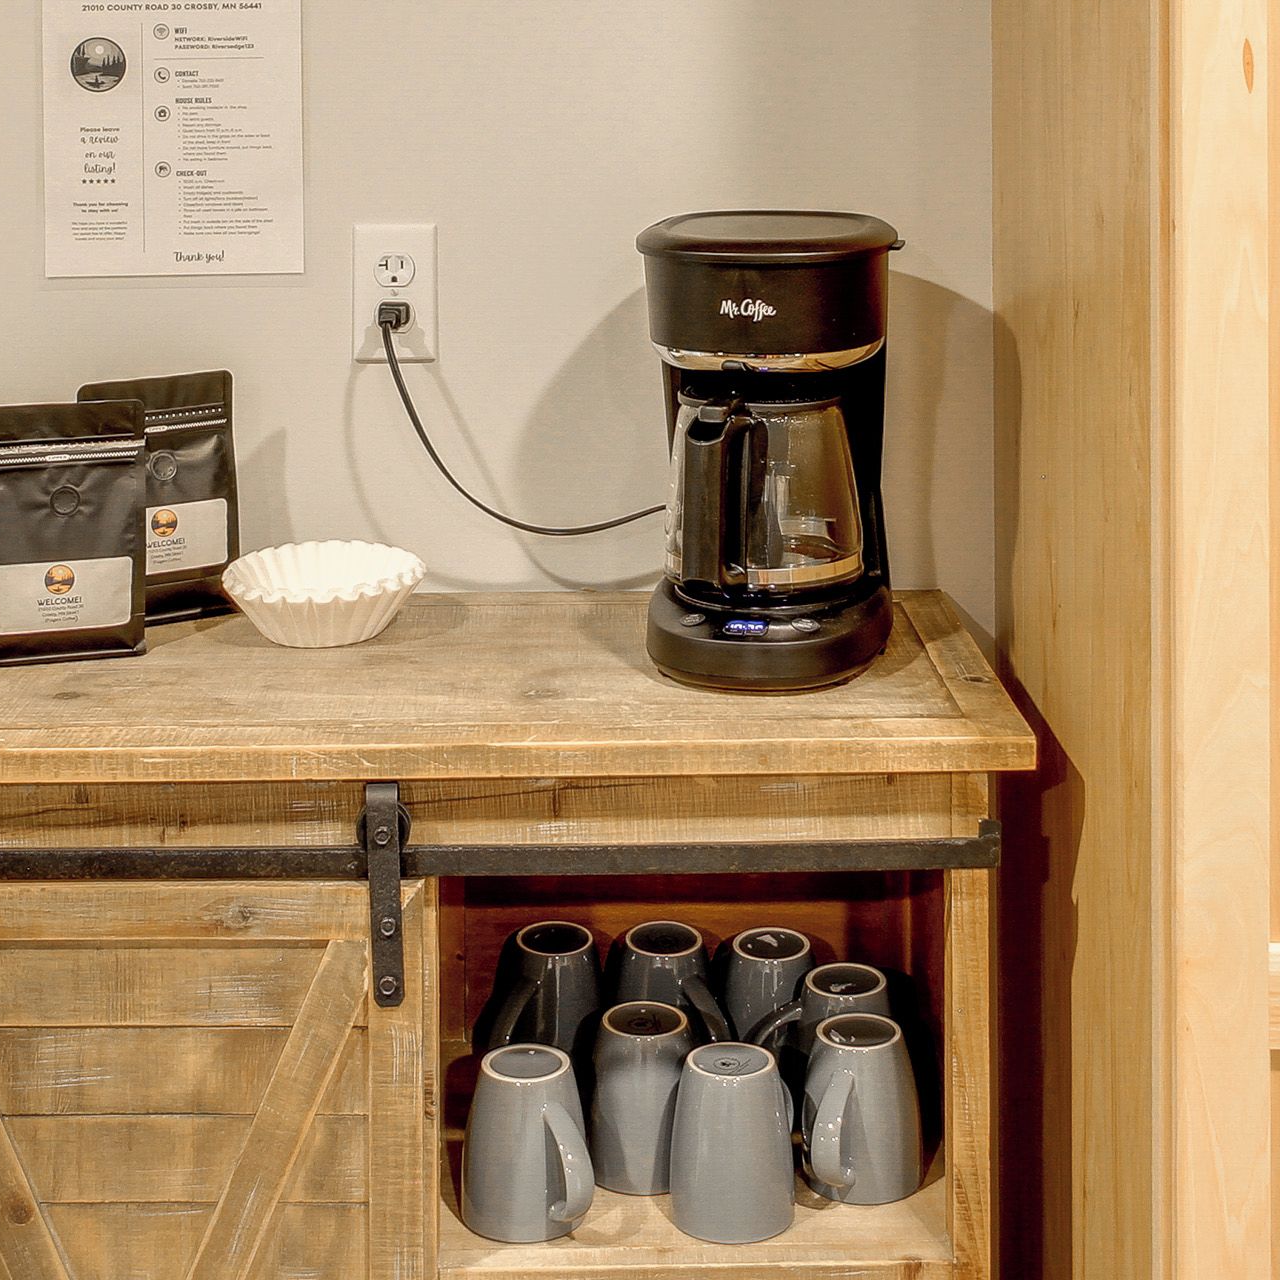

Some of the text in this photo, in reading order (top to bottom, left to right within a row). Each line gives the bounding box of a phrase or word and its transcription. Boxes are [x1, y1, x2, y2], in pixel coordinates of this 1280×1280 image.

[82, 3, 104, 11] 21010
[107, 3, 142, 11] COUNTY
[89, 136, 119, 144] review
[84, 162, 116, 175] listing!
[173, 250, 224, 263] Thank you!
[720, 299, 776, 322] Mr. Coffee
[37, 596, 82, 605] WELCOME!
